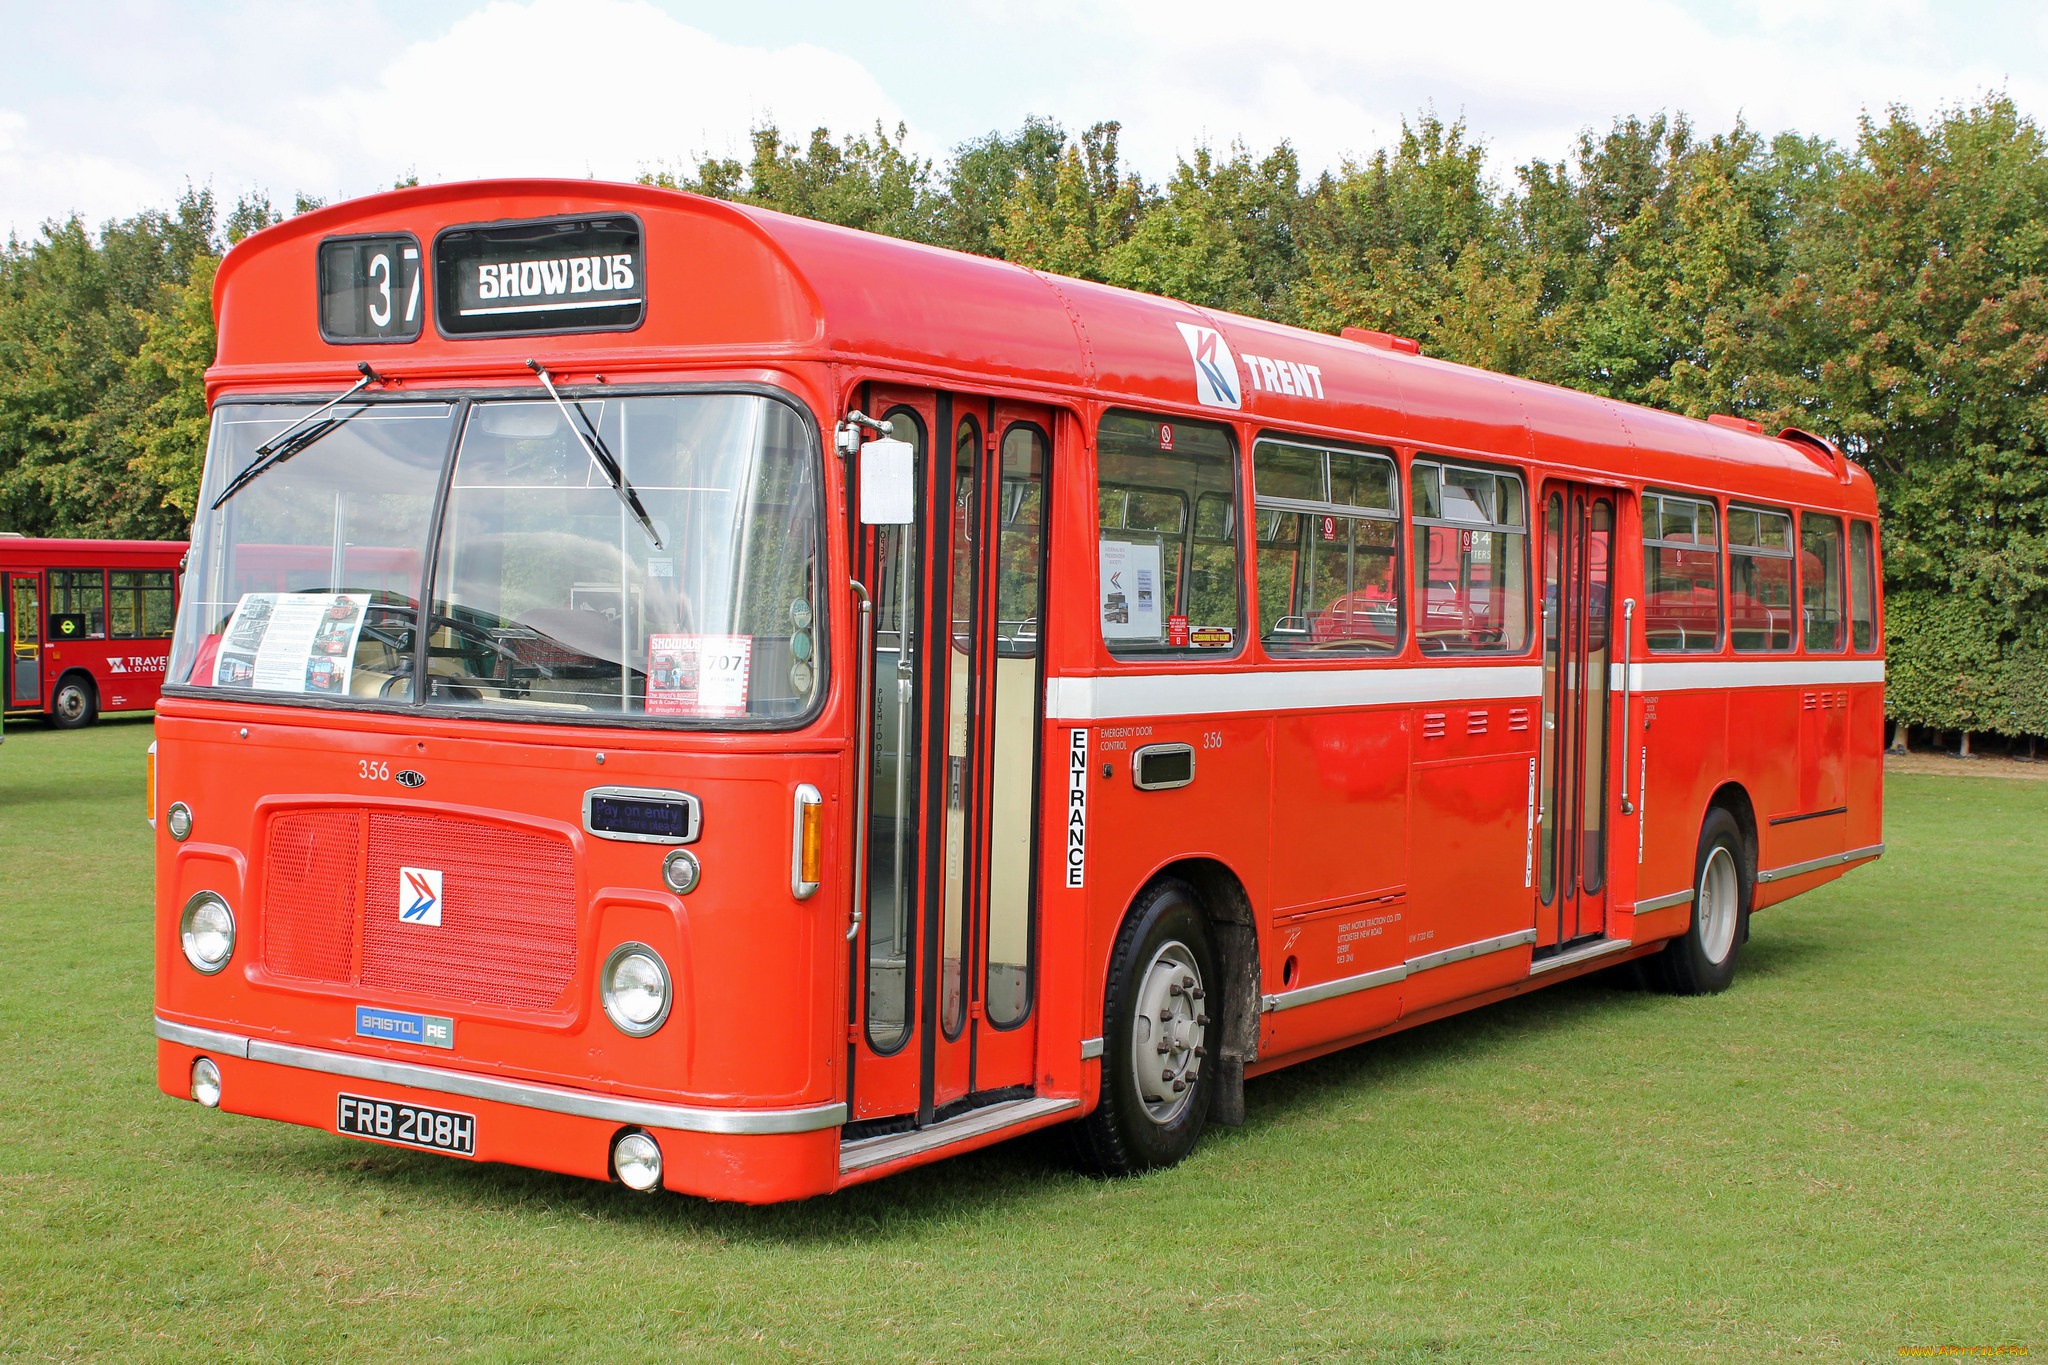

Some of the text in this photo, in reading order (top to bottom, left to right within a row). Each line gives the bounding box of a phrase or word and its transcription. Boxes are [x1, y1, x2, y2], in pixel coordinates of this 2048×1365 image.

[478, 254, 635, 300] SHOWBUS
[369, 248, 420, 327] 37
[1240, 353, 1325, 400] TRENT
[1471, 550, 1491, 559] TERS
[128, 665, 166, 673] LONDO
[708, 655, 742, 671] 707
[1100, 726, 1153, 739] EMERGENCY DOOR
[1203, 732, 1223, 749] 356
[1100, 740, 1127, 751] CONTROL
[359, 760, 390, 781] 356
[398, 771, 422, 786] ECW
[596, 801, 678, 820] Pay on entry
[1069, 731, 1086, 885] ENTRANCE
[1338, 923, 1351, 933] TRENT
[1351, 920, 1366, 930] MOTOR
[1366, 916, 1386, 926] TRACTION
[1360, 930, 1370, 938] NEW
[1370, 927, 1382, 936] ROAD
[1337, 944, 1350, 954] DERBY
[361, 1015, 447, 1039] BRISTOL AE
[340, 1098, 472, 1151] FRB 208H
